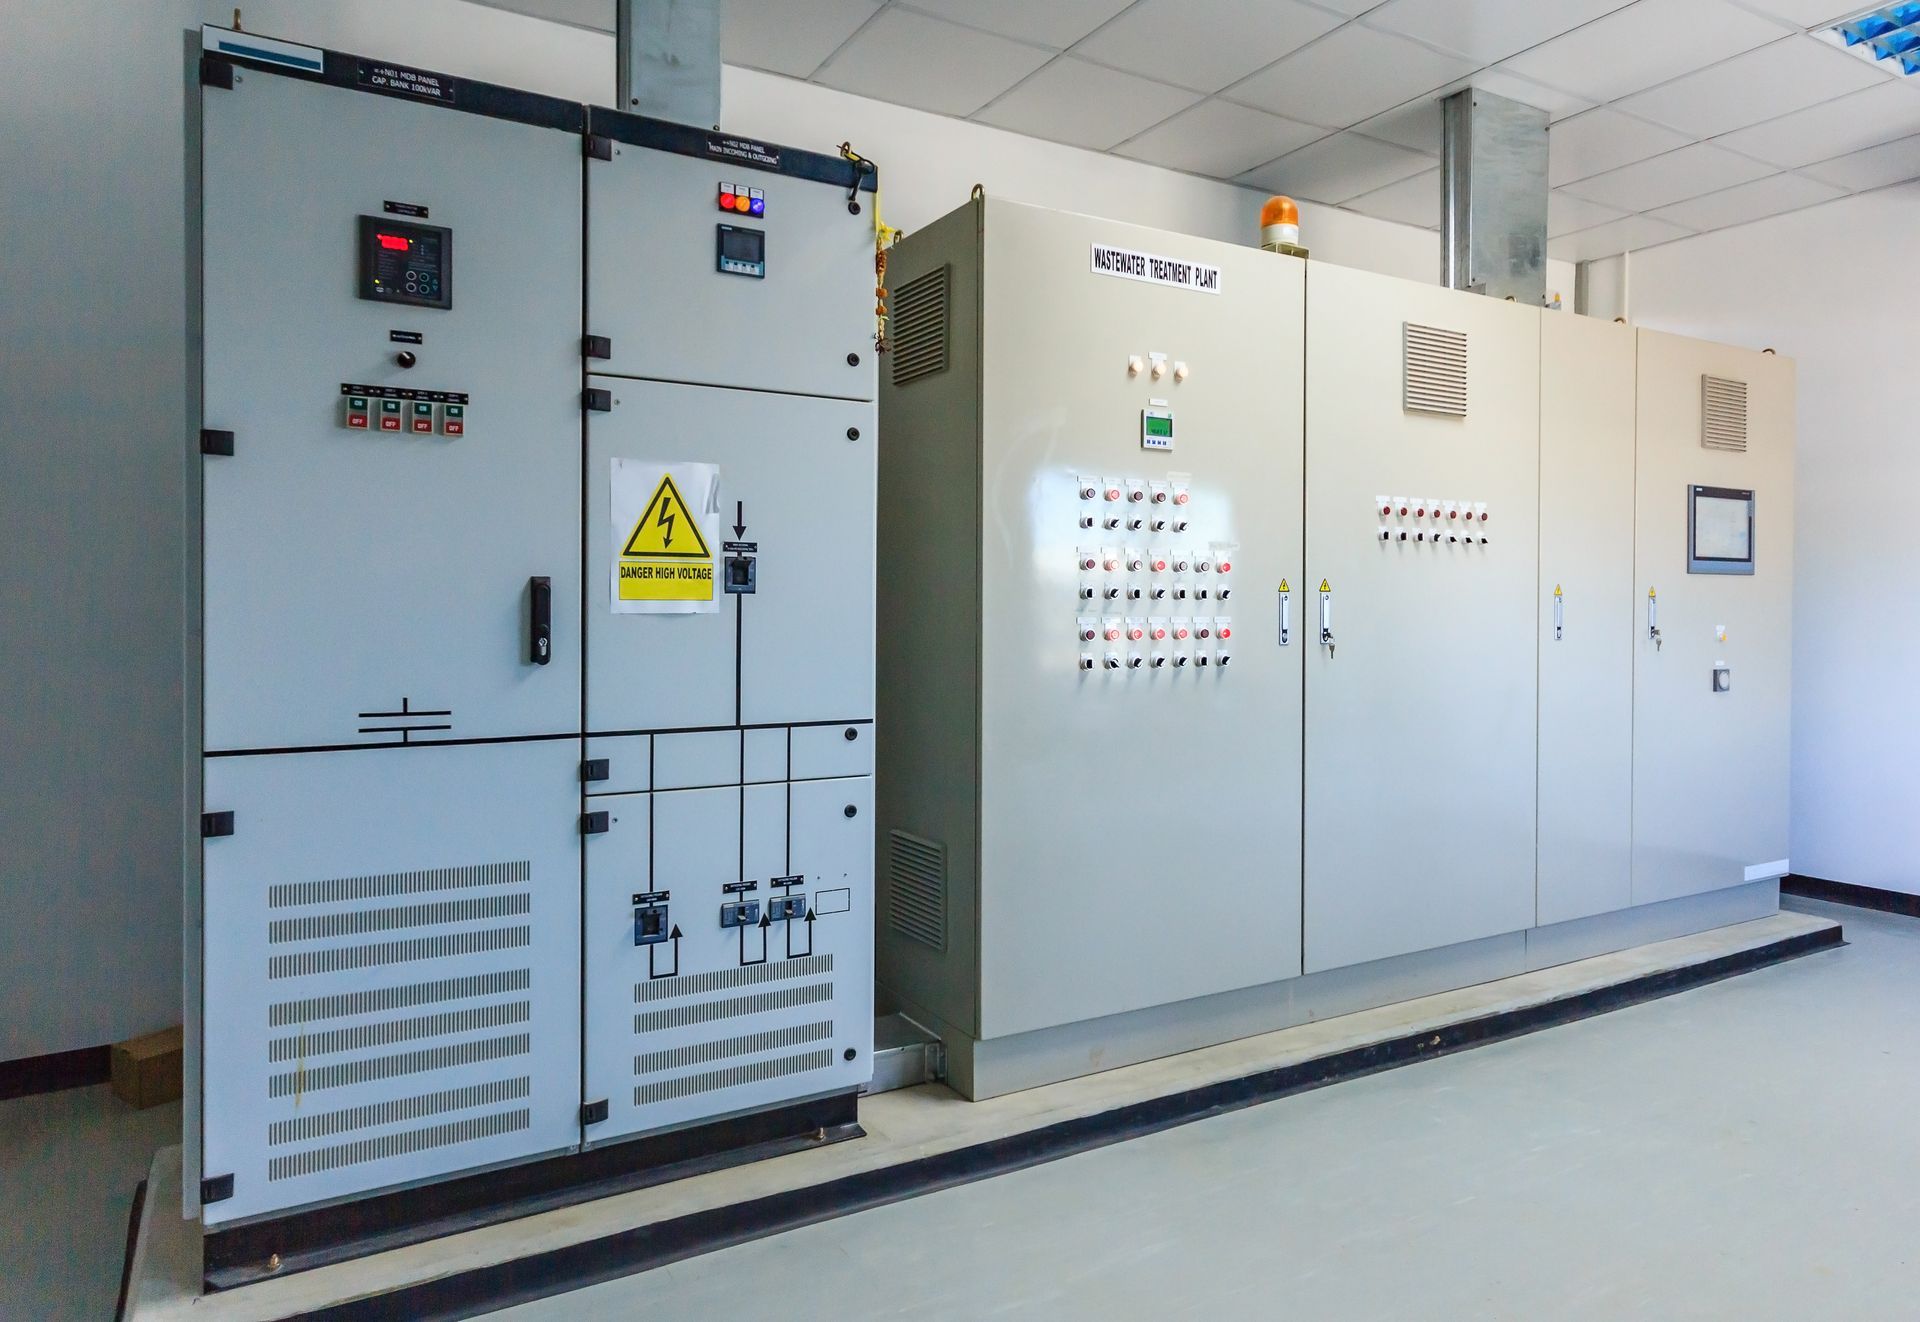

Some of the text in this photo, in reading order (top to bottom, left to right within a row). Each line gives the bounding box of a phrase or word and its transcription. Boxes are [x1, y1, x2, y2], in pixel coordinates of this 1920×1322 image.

[371, 75, 441, 96] CAP. BANK 100kVAR
[400, 72, 417, 81] MDB
[417, 75, 440, 87] PANEL
[751, 144, 765, 154] PANEL
[752, 153, 777, 164] OUTGOING
[1094, 247, 1218, 290] WASTEWATER TREATMENT PLANT
[620, 566, 712, 580] DANGER HIGH VOLTAGE
